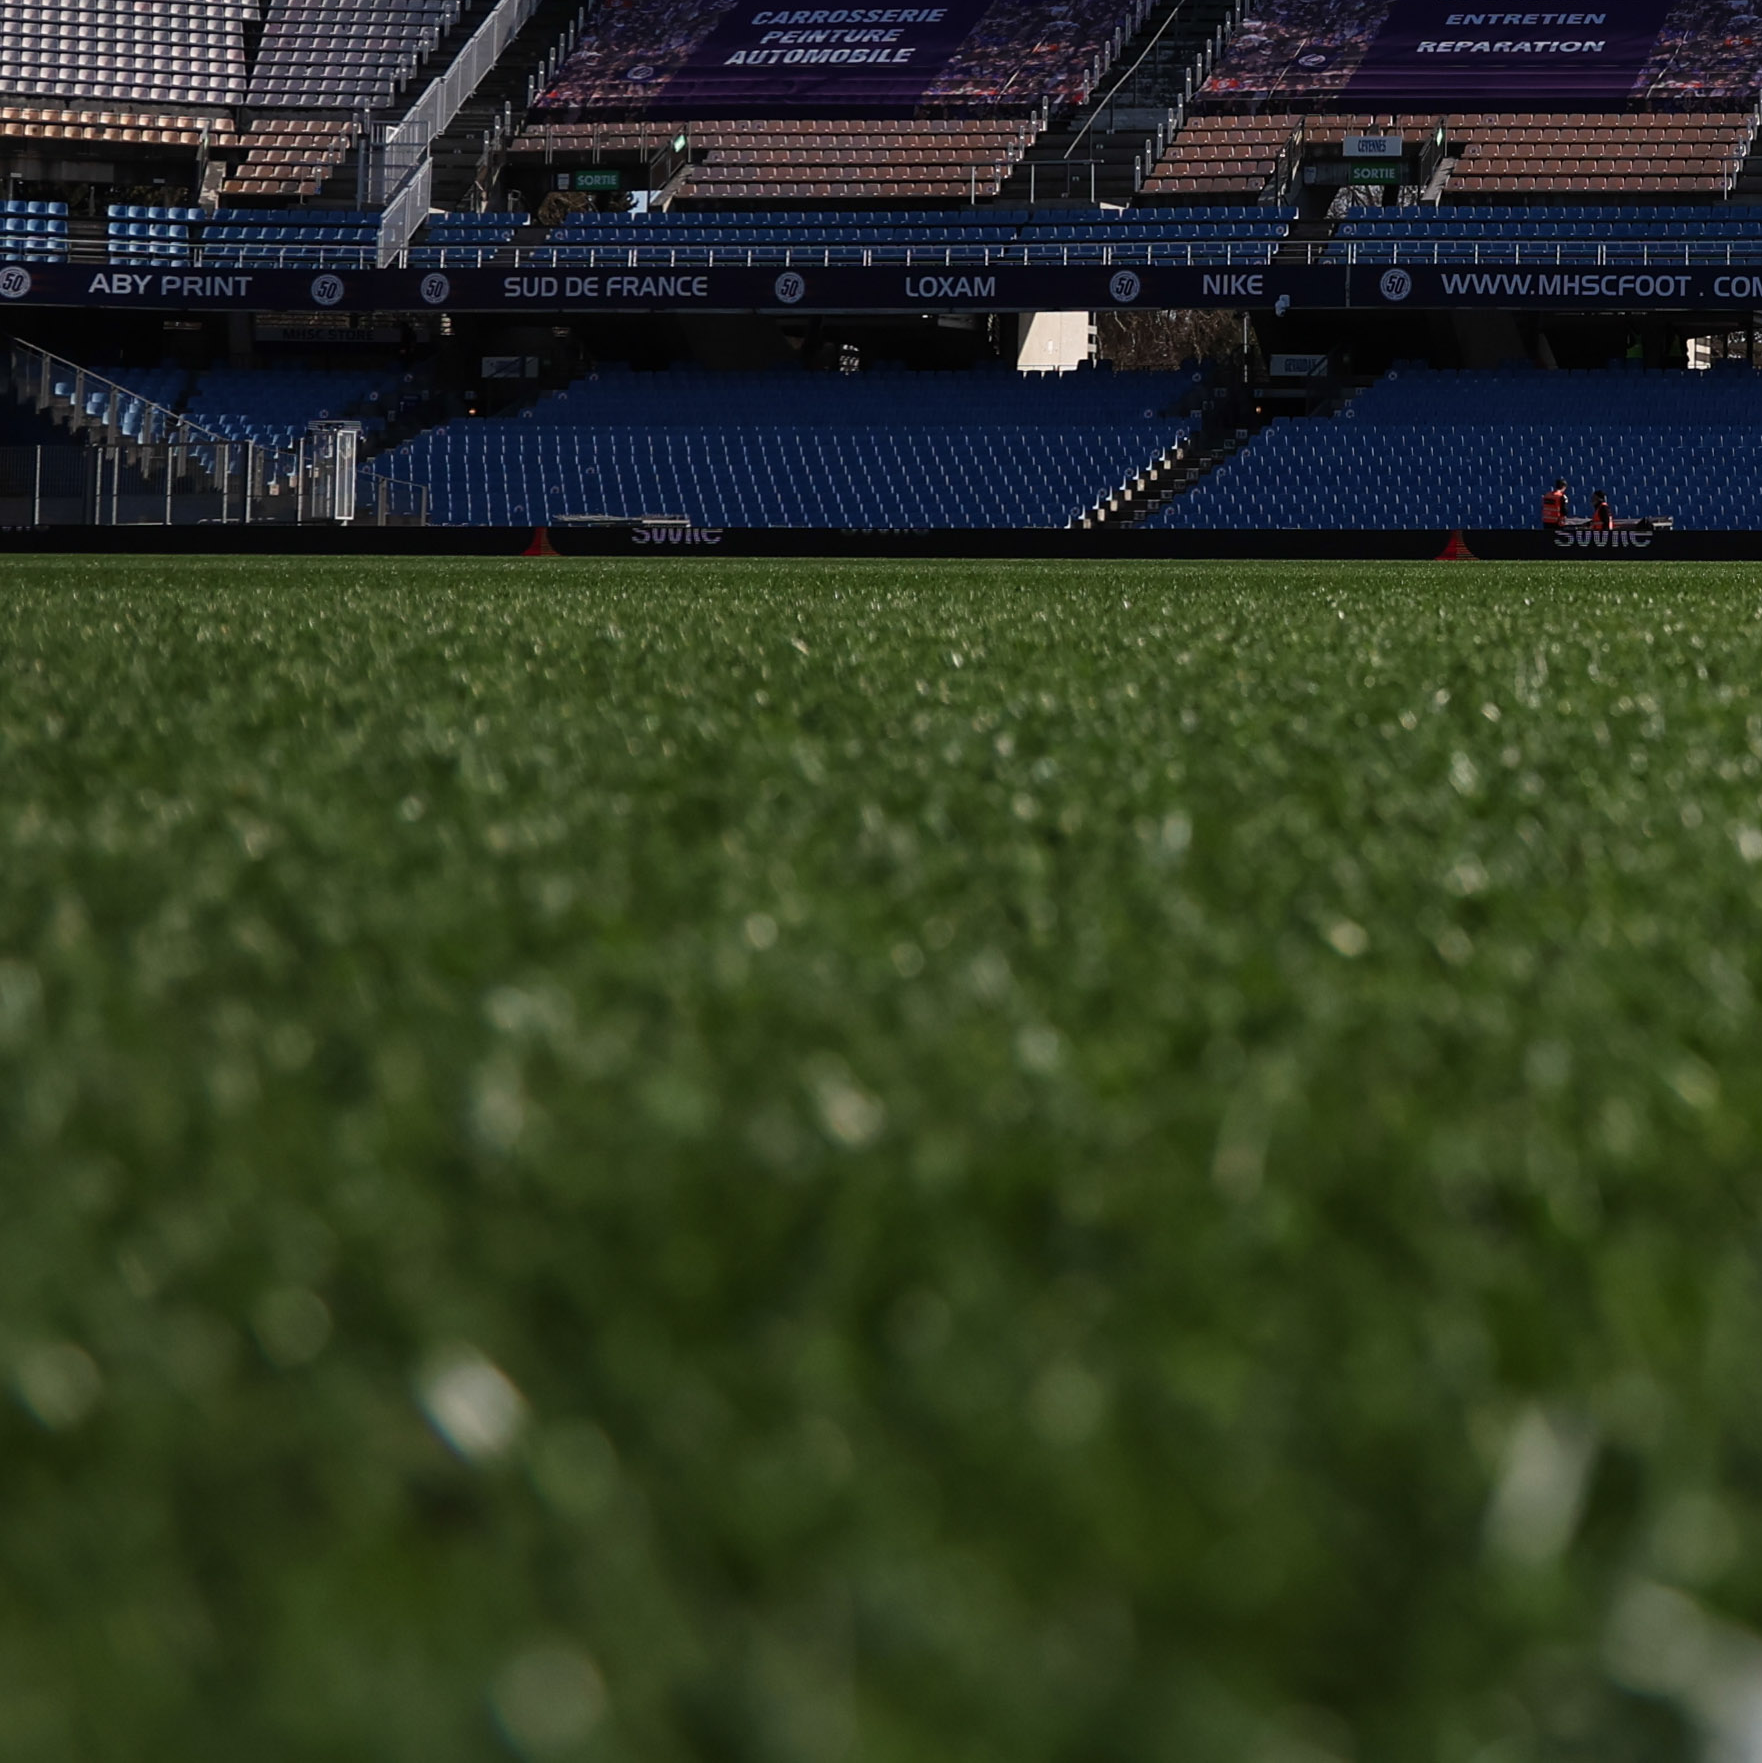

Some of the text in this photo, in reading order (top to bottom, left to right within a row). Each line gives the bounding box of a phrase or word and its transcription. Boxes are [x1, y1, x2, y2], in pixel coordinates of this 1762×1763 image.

[752, 8, 948, 25] CARROSSERIE
[1445, 13, 1606, 26] ENTRETIEN
[760, 29, 905, 44] PEINTURE
[1416, 40, 1606, 53] REPARATION
[724, 47, 916, 66] AUTOMOBILE
[577, 175, 617, 186] SORTIE
[1353, 167, 1395, 179] SORTIE
[88, 273, 253, 297] ABY PRINT
[503, 276, 709, 298] SUD DE FRANCE
[905, 276, 996, 298] LOXAM
[1202, 274, 1264, 295] NIKE
[283, 329, 376, 341] MHSC STORE
